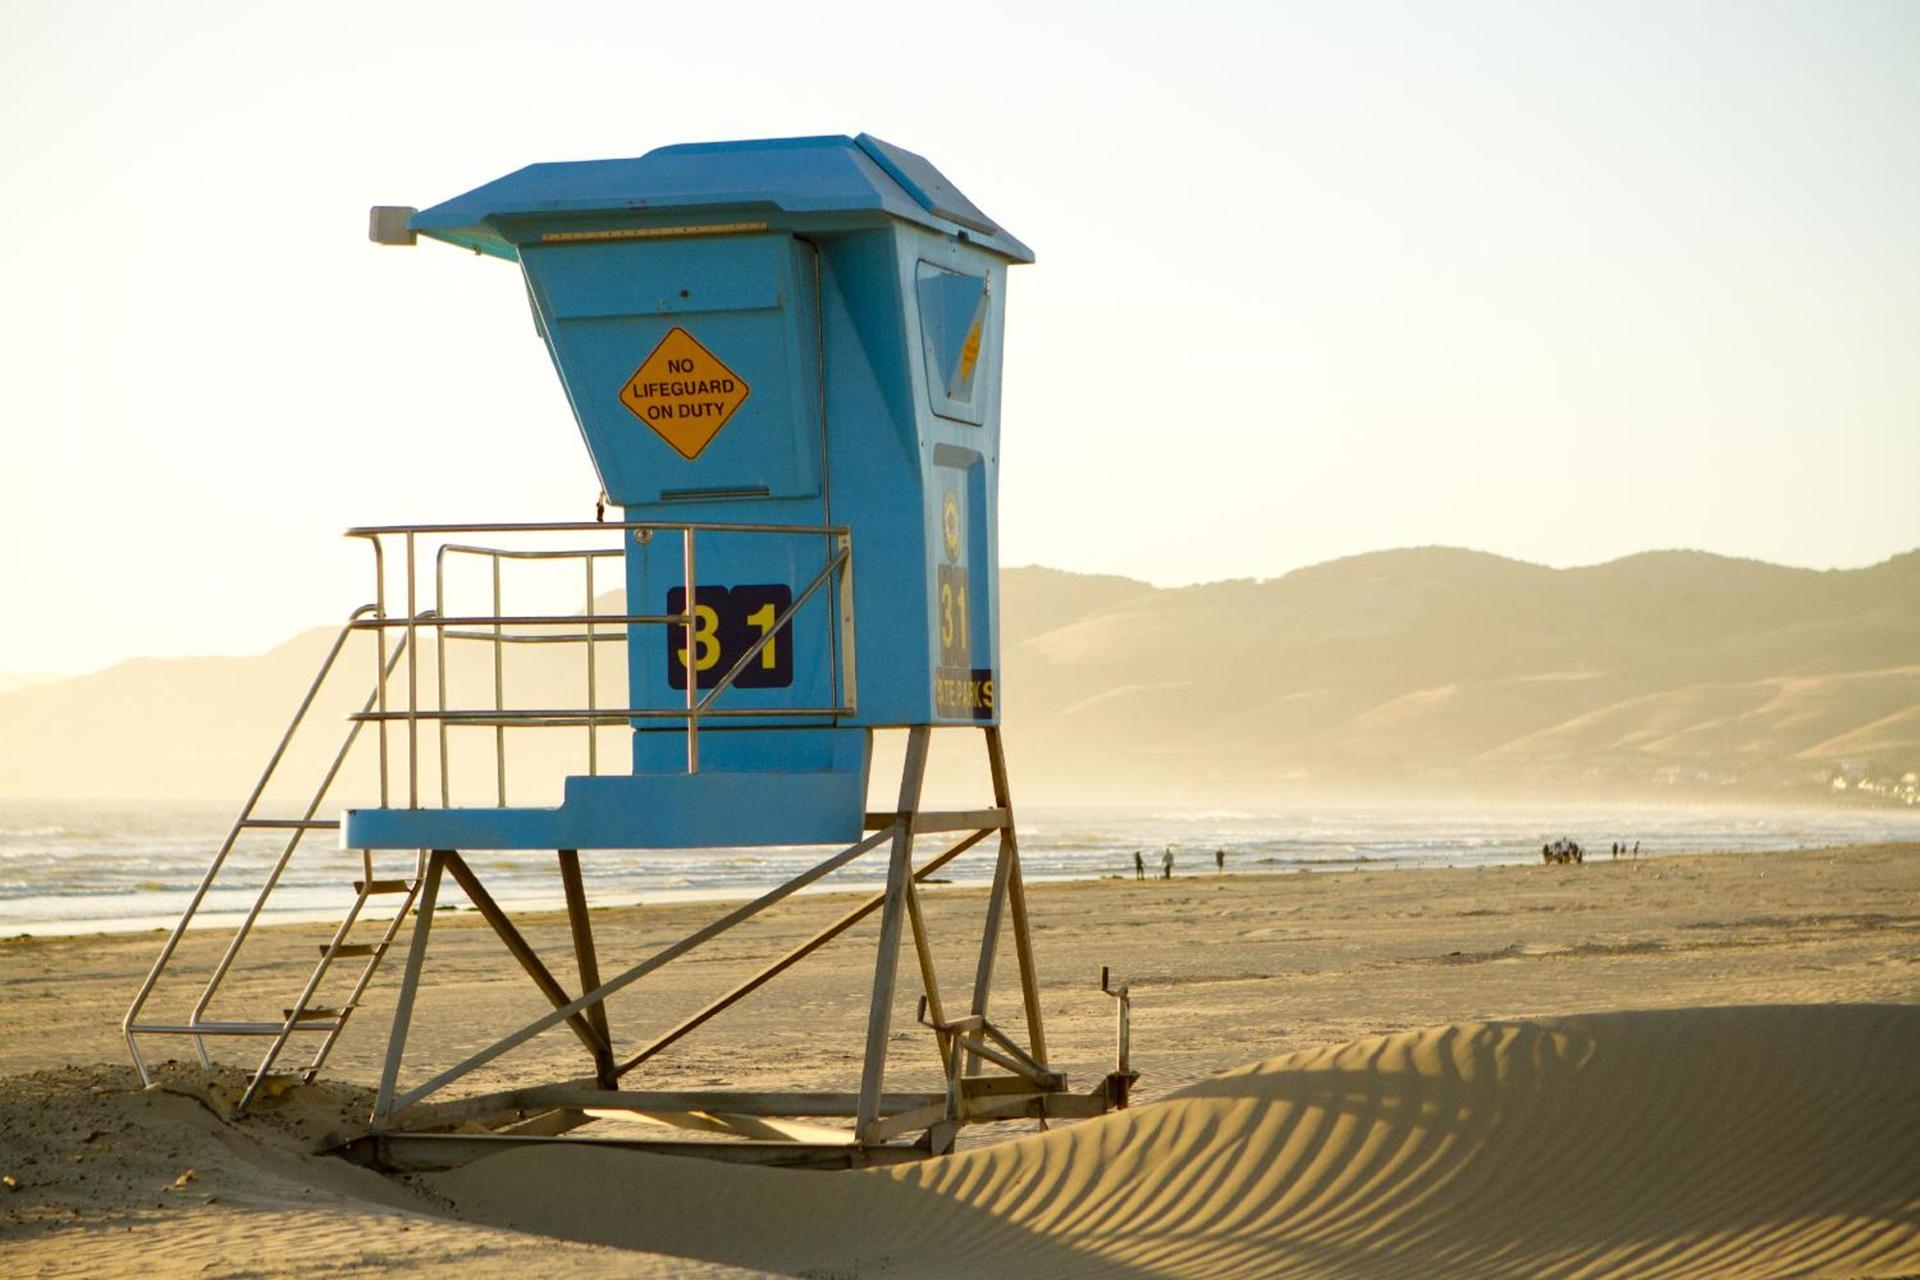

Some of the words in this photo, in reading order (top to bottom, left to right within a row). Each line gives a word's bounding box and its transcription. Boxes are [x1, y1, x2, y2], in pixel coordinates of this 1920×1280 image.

[668, 358, 695, 374] NO
[632, 379, 735, 399] LIFEGUARD
[647, 405, 673, 420] ON
[678, 402, 725, 418] DUTY
[941, 583, 967, 650] 31
[677, 603, 776, 671] 31
